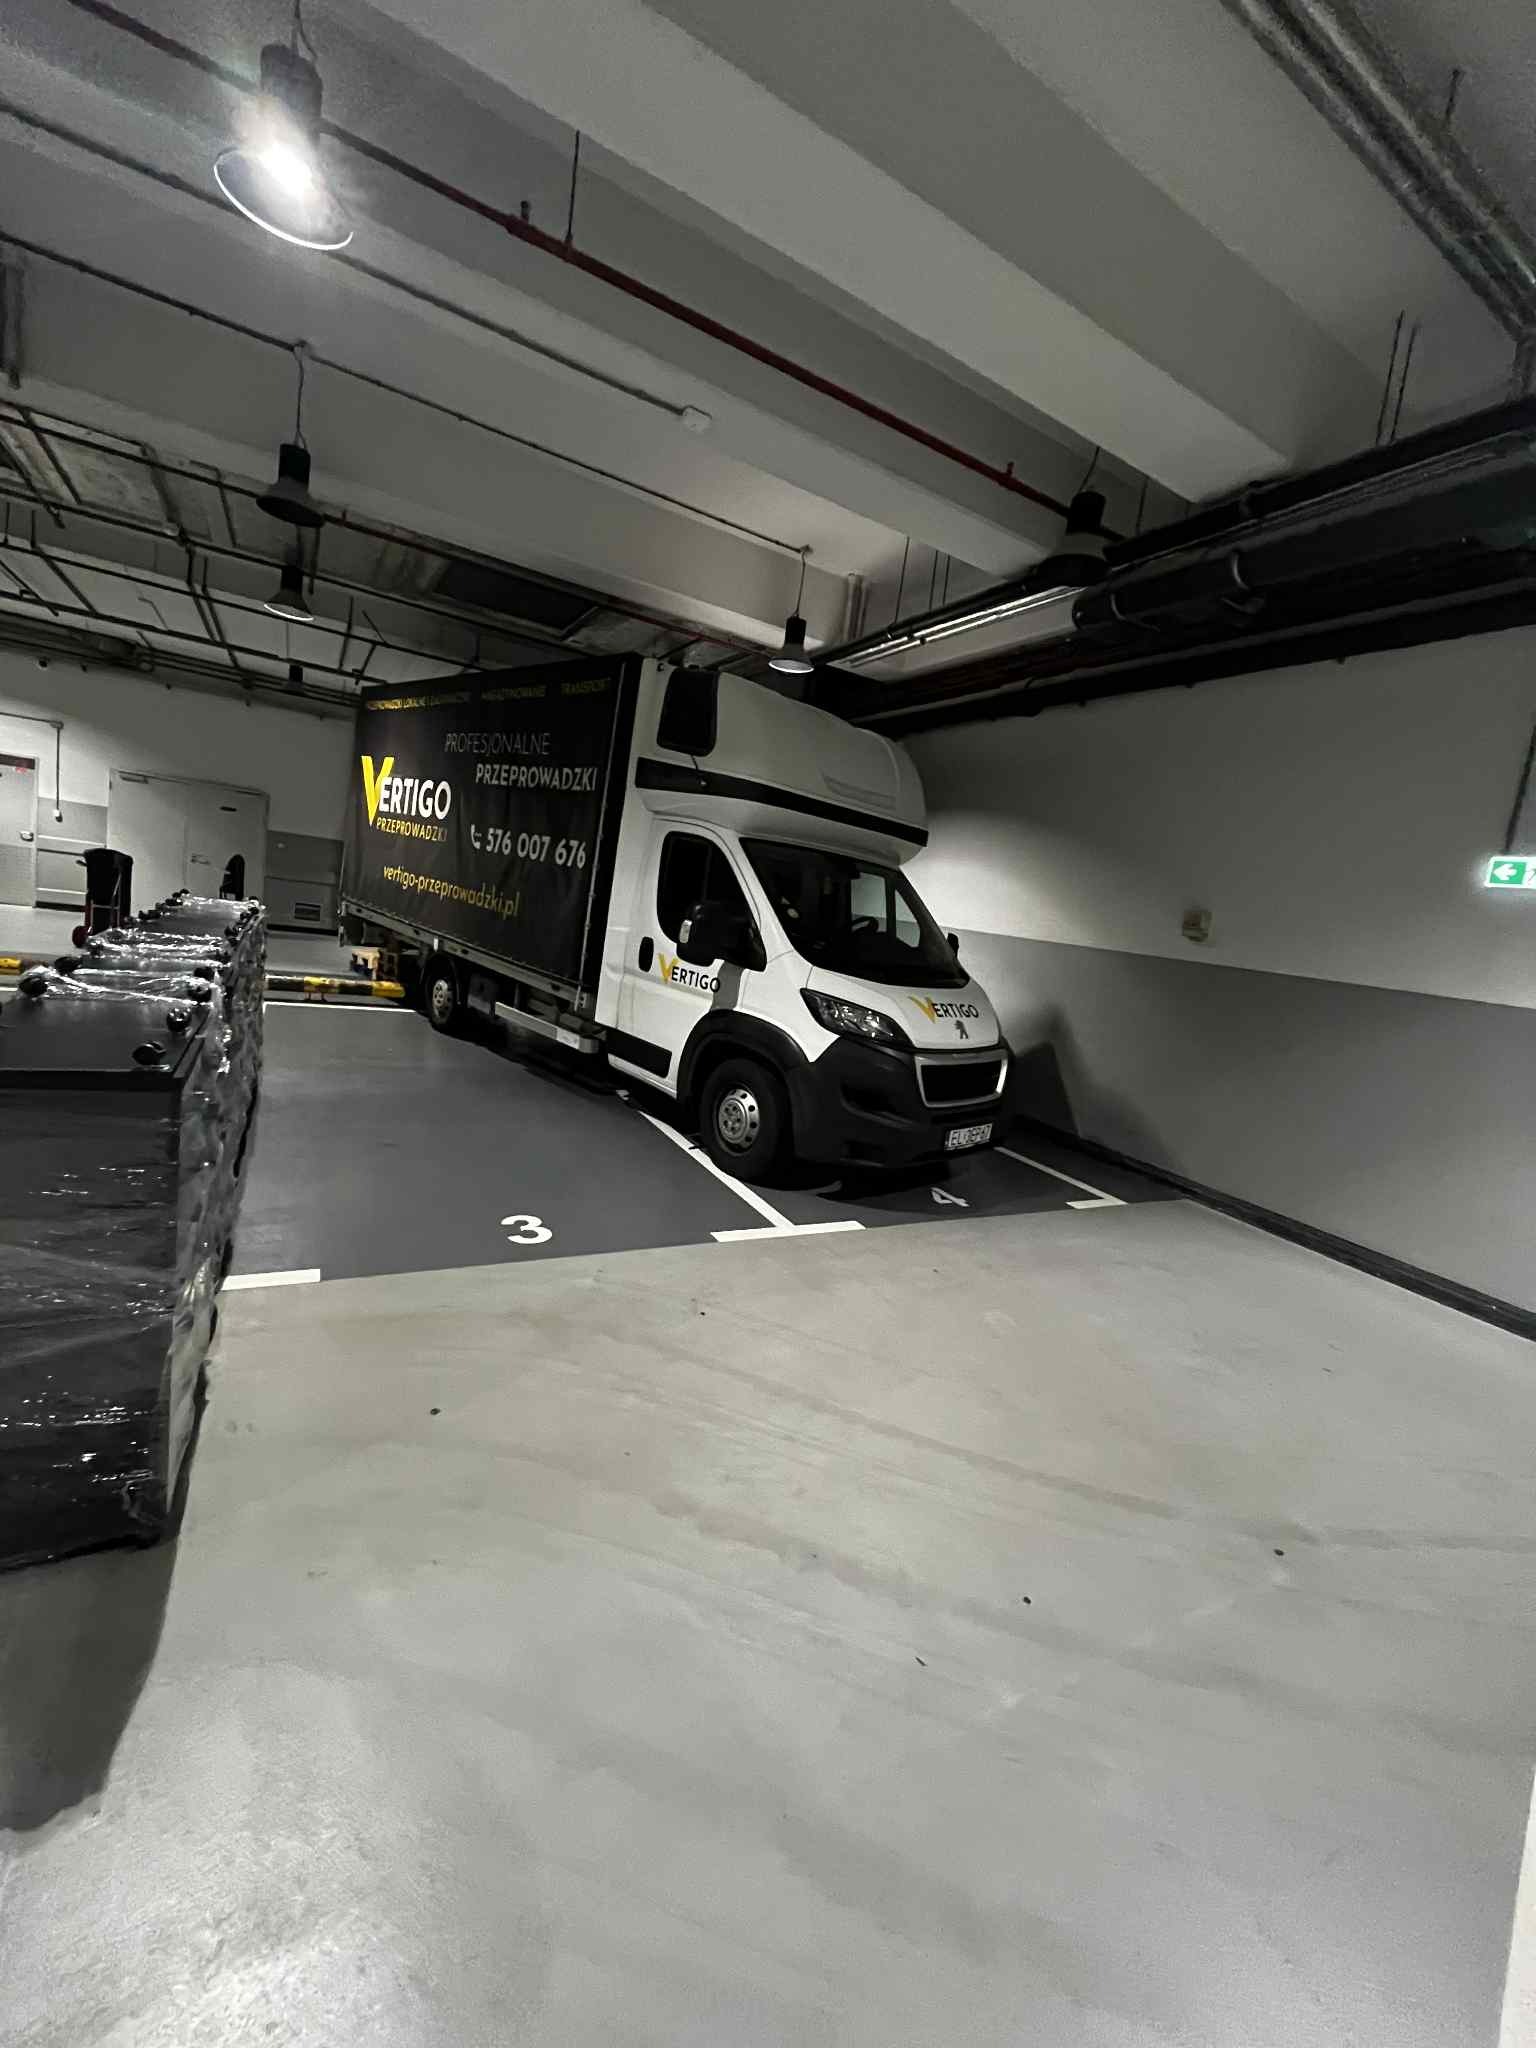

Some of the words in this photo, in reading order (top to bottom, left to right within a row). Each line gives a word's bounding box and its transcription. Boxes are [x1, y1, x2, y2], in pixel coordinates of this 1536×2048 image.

[444, 732, 551, 755] PROFESJONALNE
[361, 755, 452, 827] VERTIGO
[475, 763, 599, 792] PRZEPROWADZKI
[376, 817, 448, 843] PRZEPROWADZKI
[486, 827, 512, 855] 576
[517, 833, 551, 862] 007
[555, 839, 587, 869] 676
[383, 865, 521, 920] vertigo-przeprowadzki.pl
[658, 953, 721, 993] VERTIGO
[909, 995, 979, 1023] VERTIGO
[931, 1187, 969, 1207] 4
[501, 1215, 552, 1244] 3
